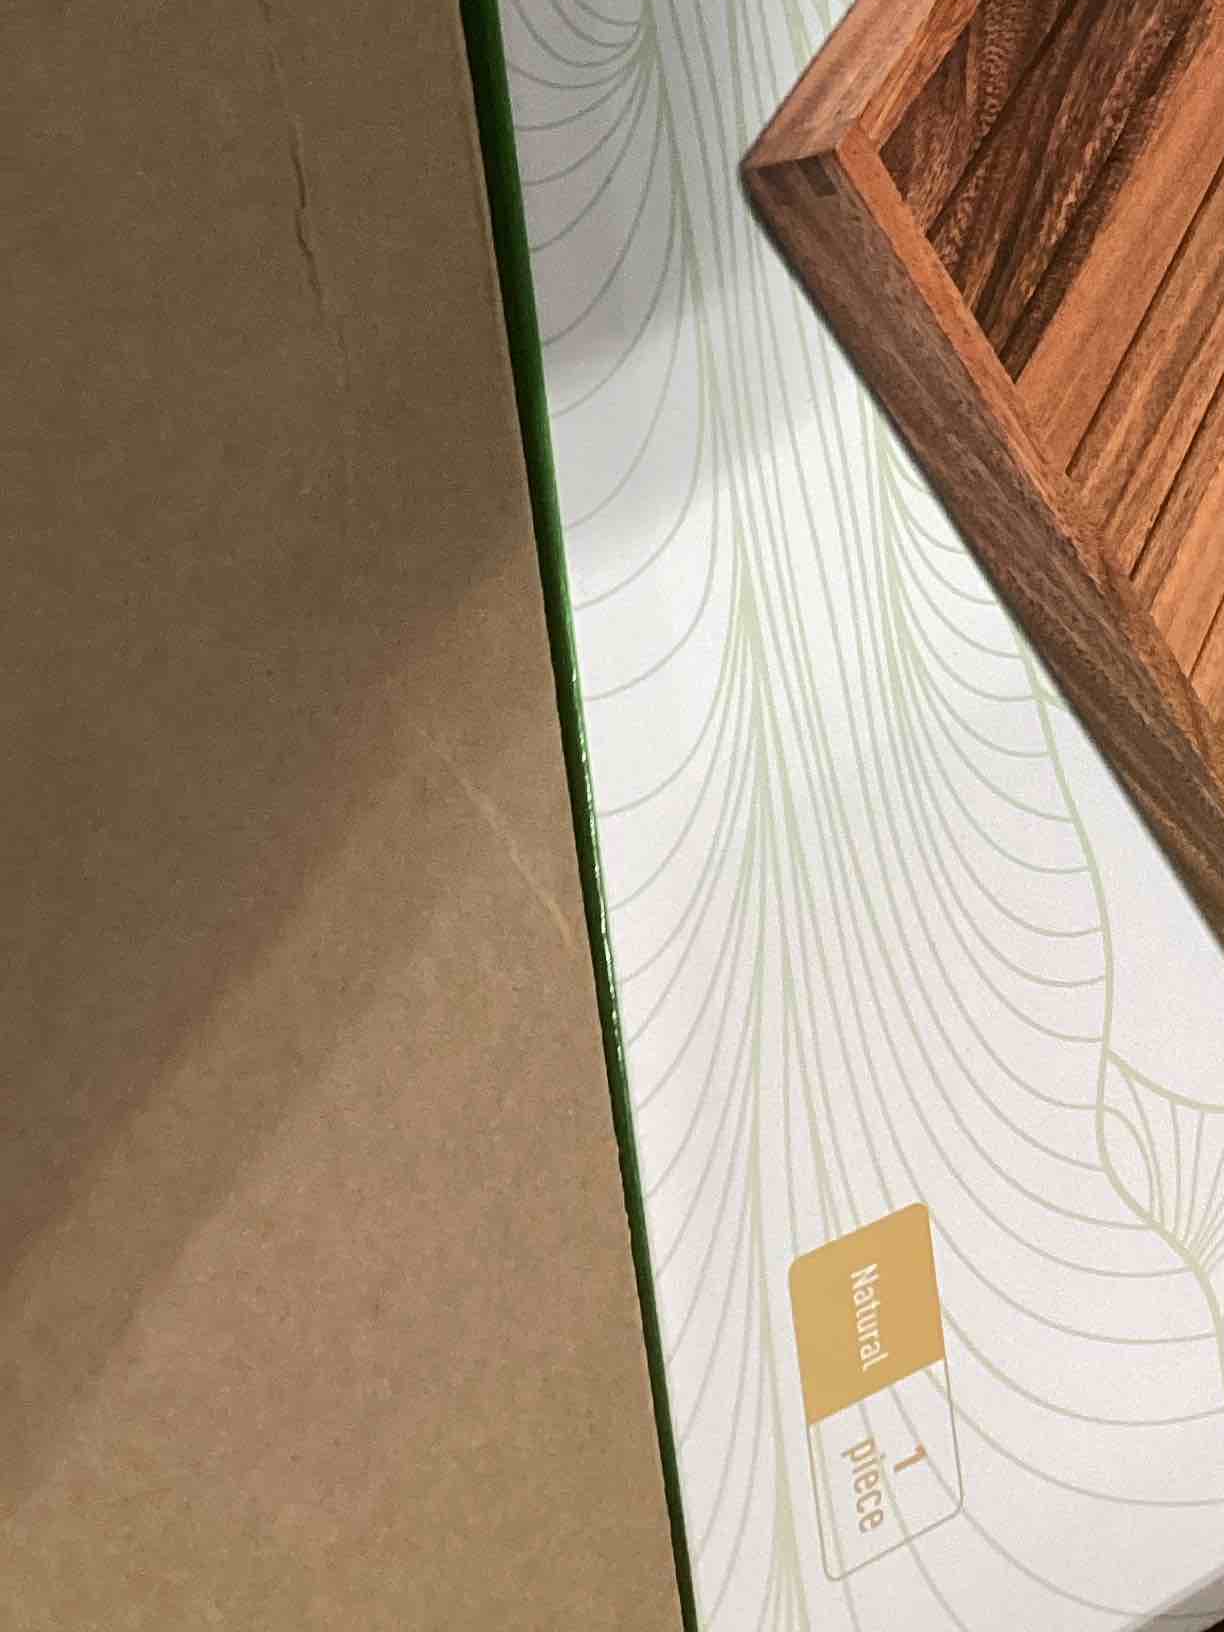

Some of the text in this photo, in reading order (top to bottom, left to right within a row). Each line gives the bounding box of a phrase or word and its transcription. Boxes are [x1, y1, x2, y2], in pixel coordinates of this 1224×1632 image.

[850, 1263, 888, 1371] Natural
[841, 1438, 887, 1533] piece
[894, 1441, 929, 1472] 1
